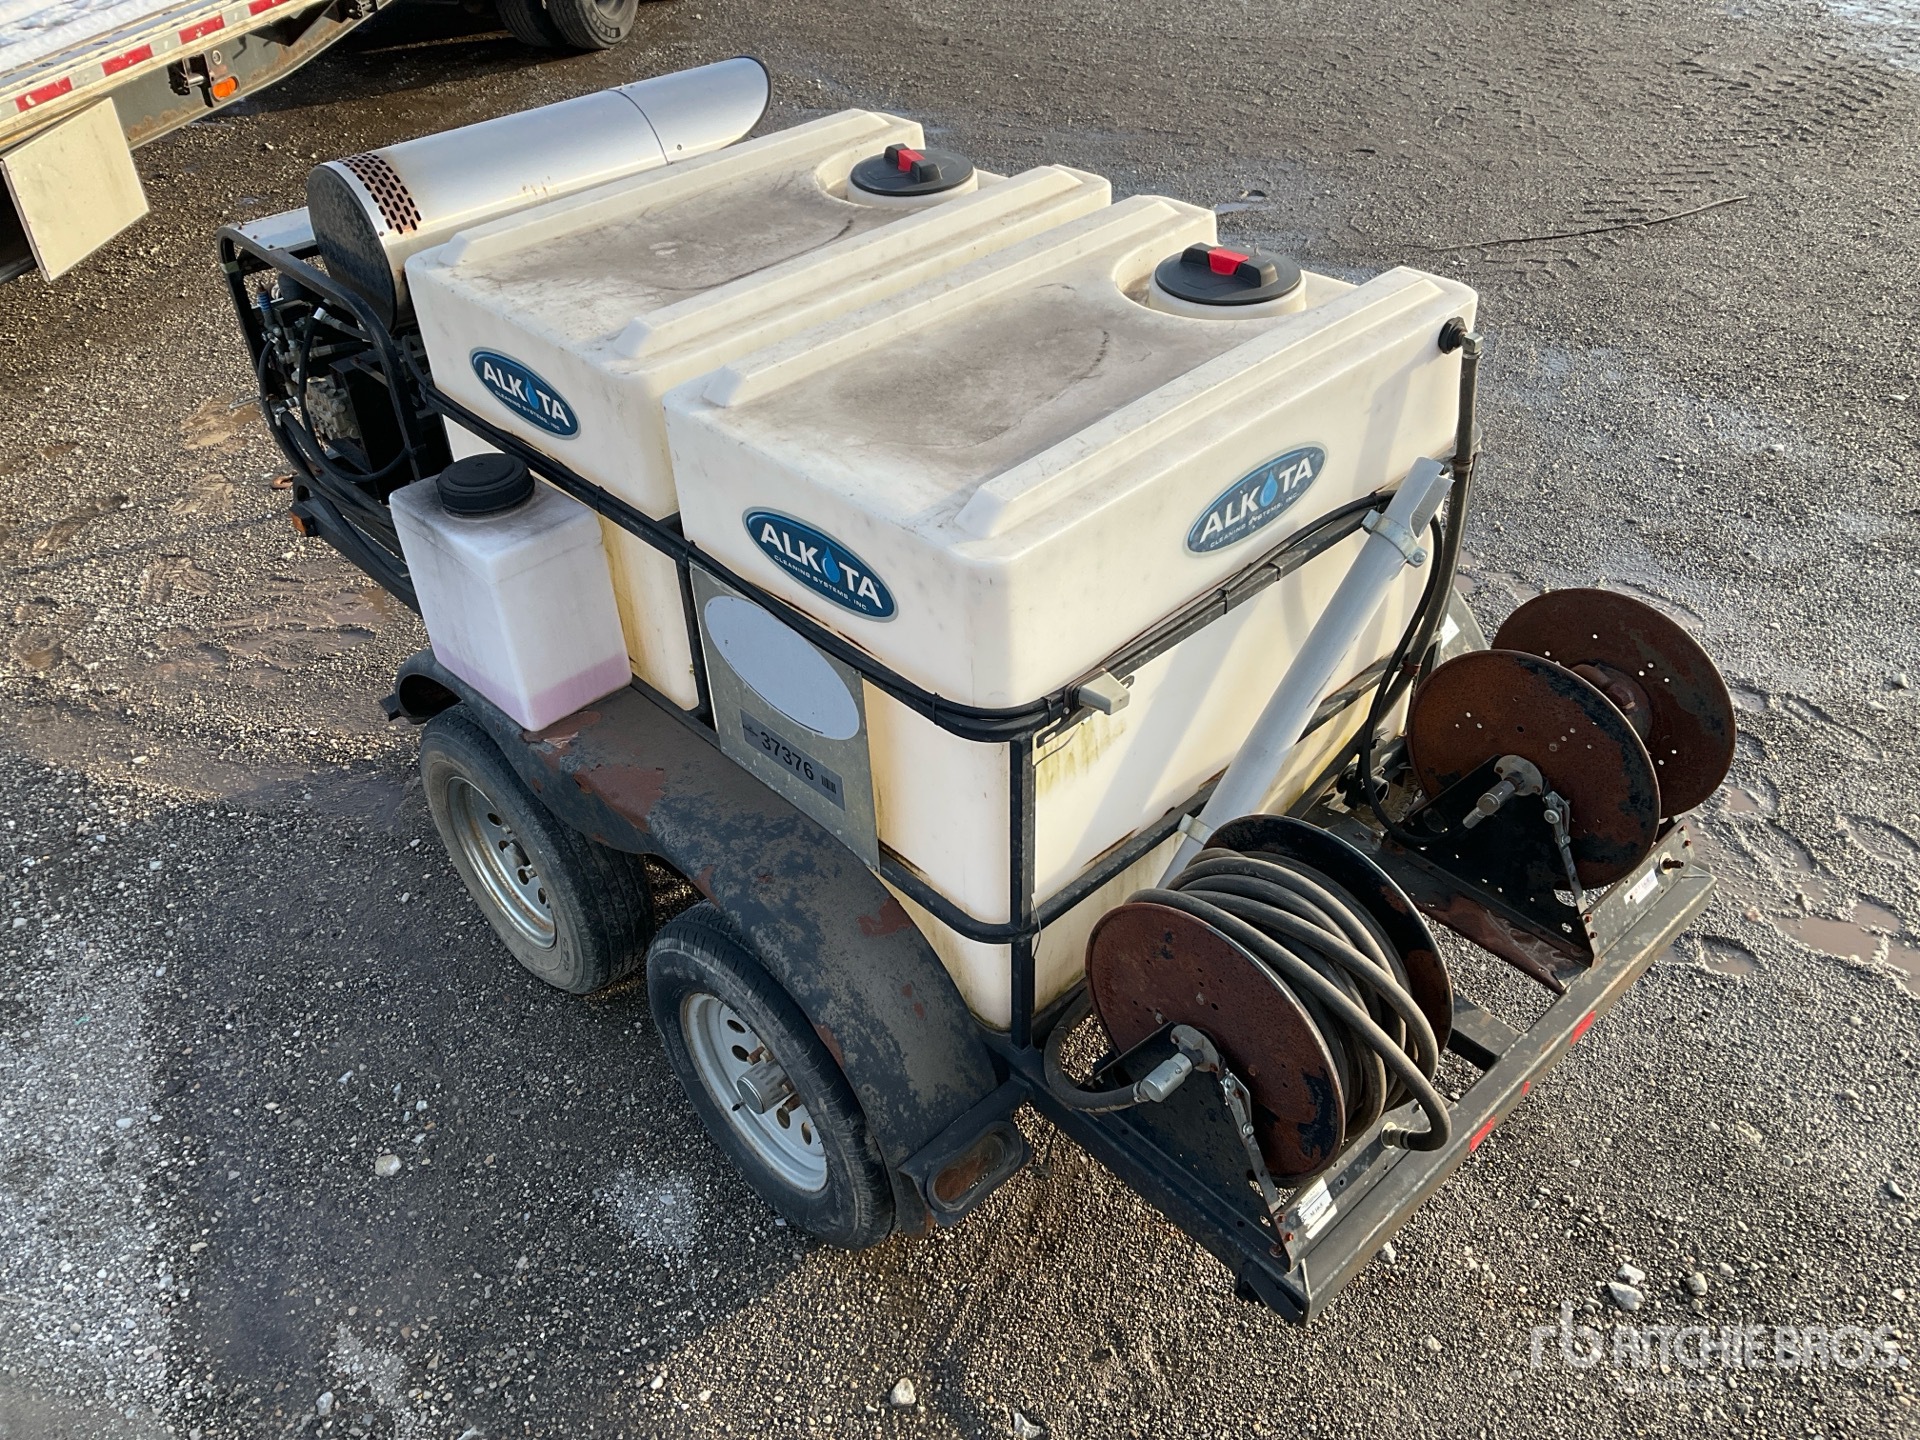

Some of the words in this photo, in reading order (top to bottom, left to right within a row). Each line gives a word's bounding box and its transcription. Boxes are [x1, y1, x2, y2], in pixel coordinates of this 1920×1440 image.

[773, 554, 811, 578] CLEANING
[853, 598, 870, 612] INC.
[760, 731, 815, 781] 37376
